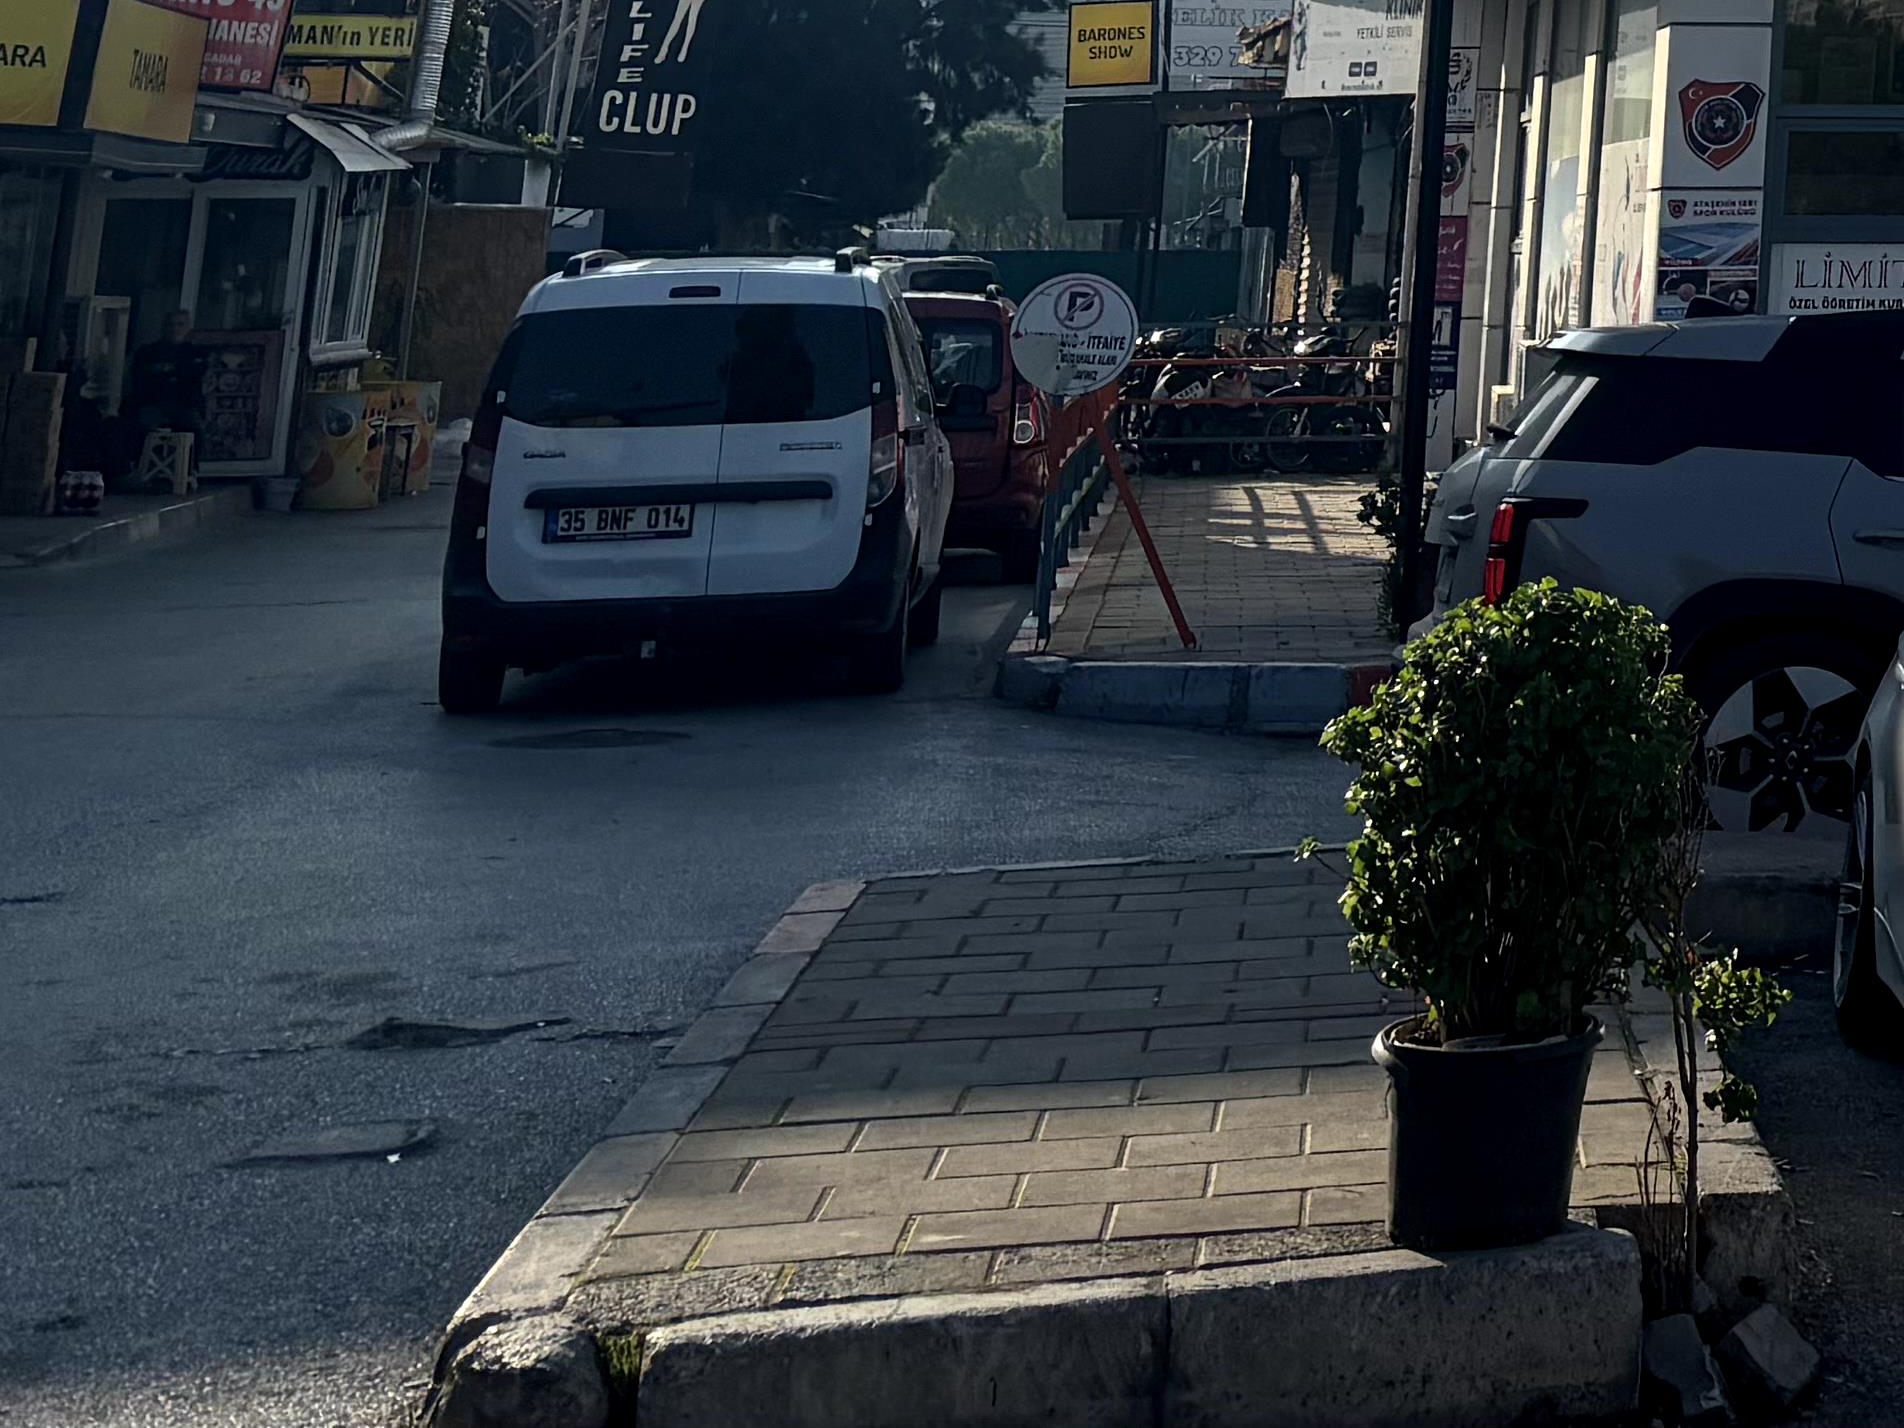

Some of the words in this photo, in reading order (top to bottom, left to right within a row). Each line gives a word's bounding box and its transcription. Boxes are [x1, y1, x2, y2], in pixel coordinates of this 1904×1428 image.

[617, 1, 652, 82] LIFE
[1078, 26, 1145, 42] BARONES
[1089, 45, 1133, 59] SHOW
[600, 89, 696, 135] CLUP
[1789, 296, 1818, 310] ÖZEL
[560, 510, 585, 532] 35
[597, 508, 636, 531] BNF
[647, 506, 685, 529] 014
